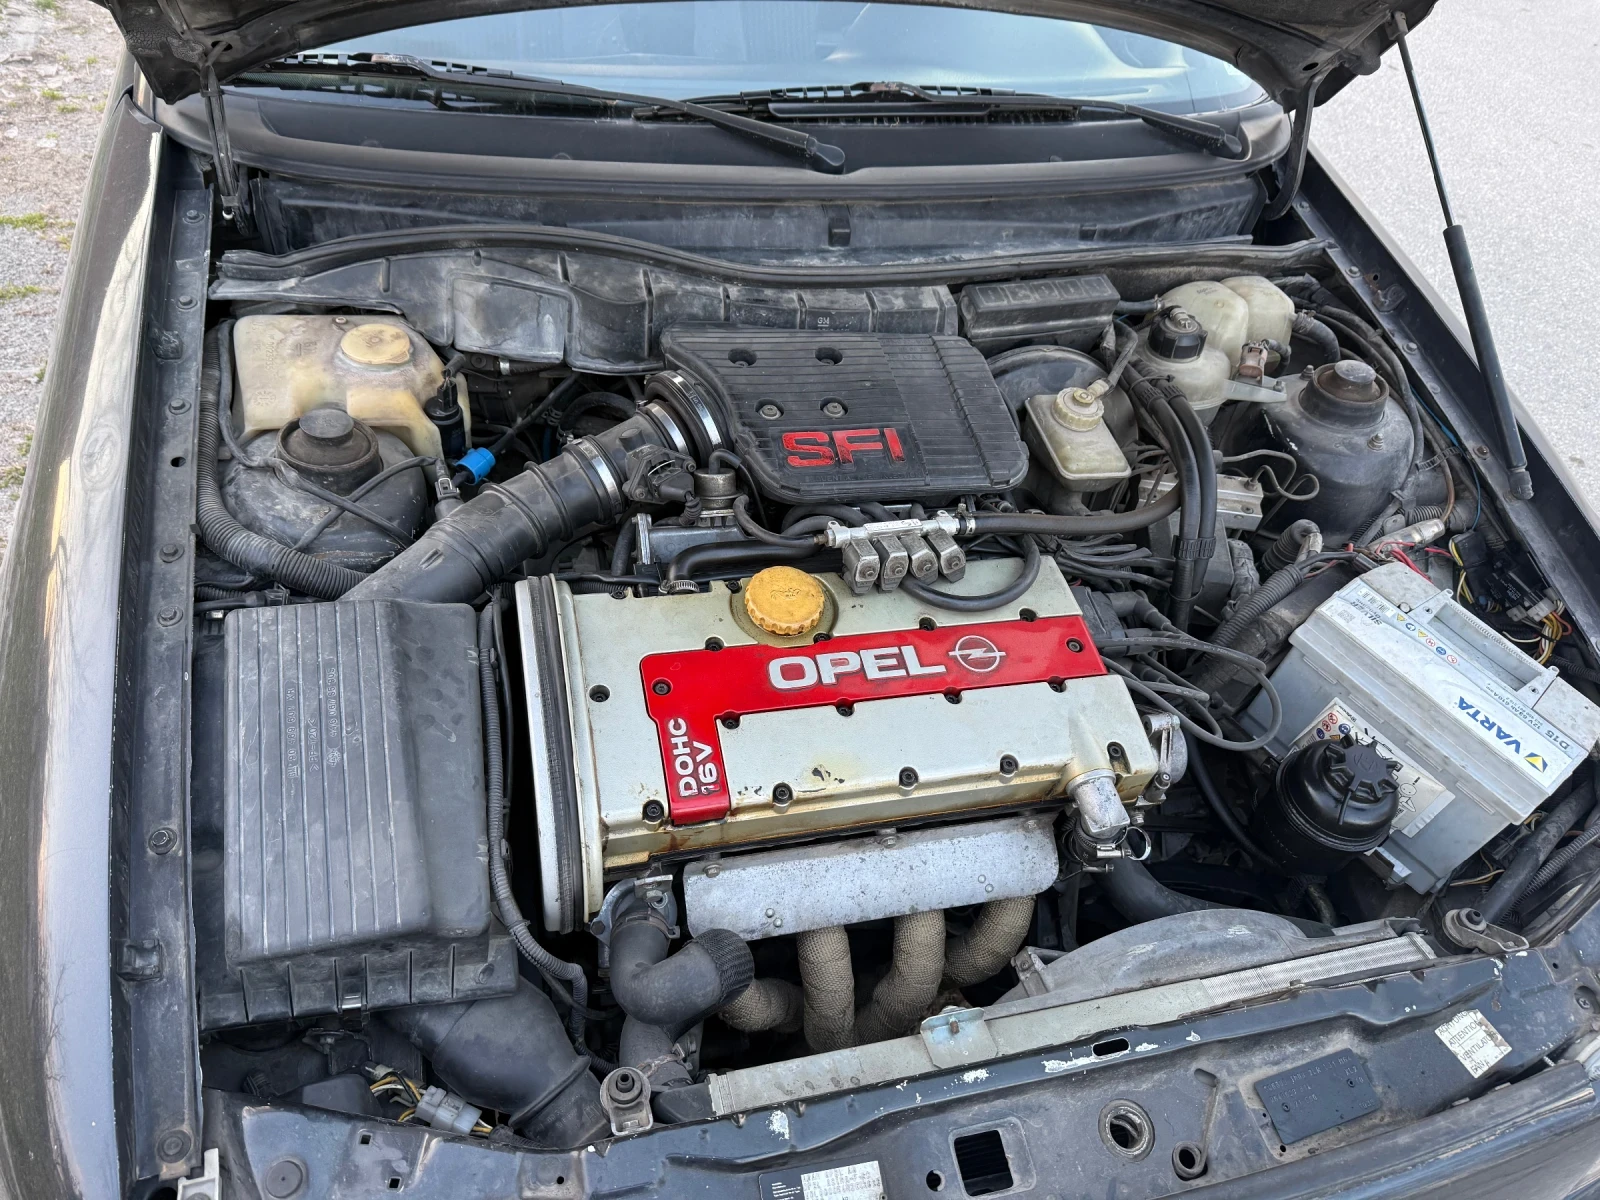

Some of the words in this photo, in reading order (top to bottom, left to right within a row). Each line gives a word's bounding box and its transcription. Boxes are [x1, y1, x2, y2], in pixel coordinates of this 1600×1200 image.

[782, 427, 906, 467] SFI
[1350, 601, 1382, 625] SILVER
[768, 644, 947, 690] OPEL
[1458, 696, 1521, 754] VARTA
[1545, 729, 1571, 750] D15
[668, 717, 698, 796] DOHC
[692, 740, 721, 795] 16V
[1460, 1030, 1496, 1061] VENTILATOR
